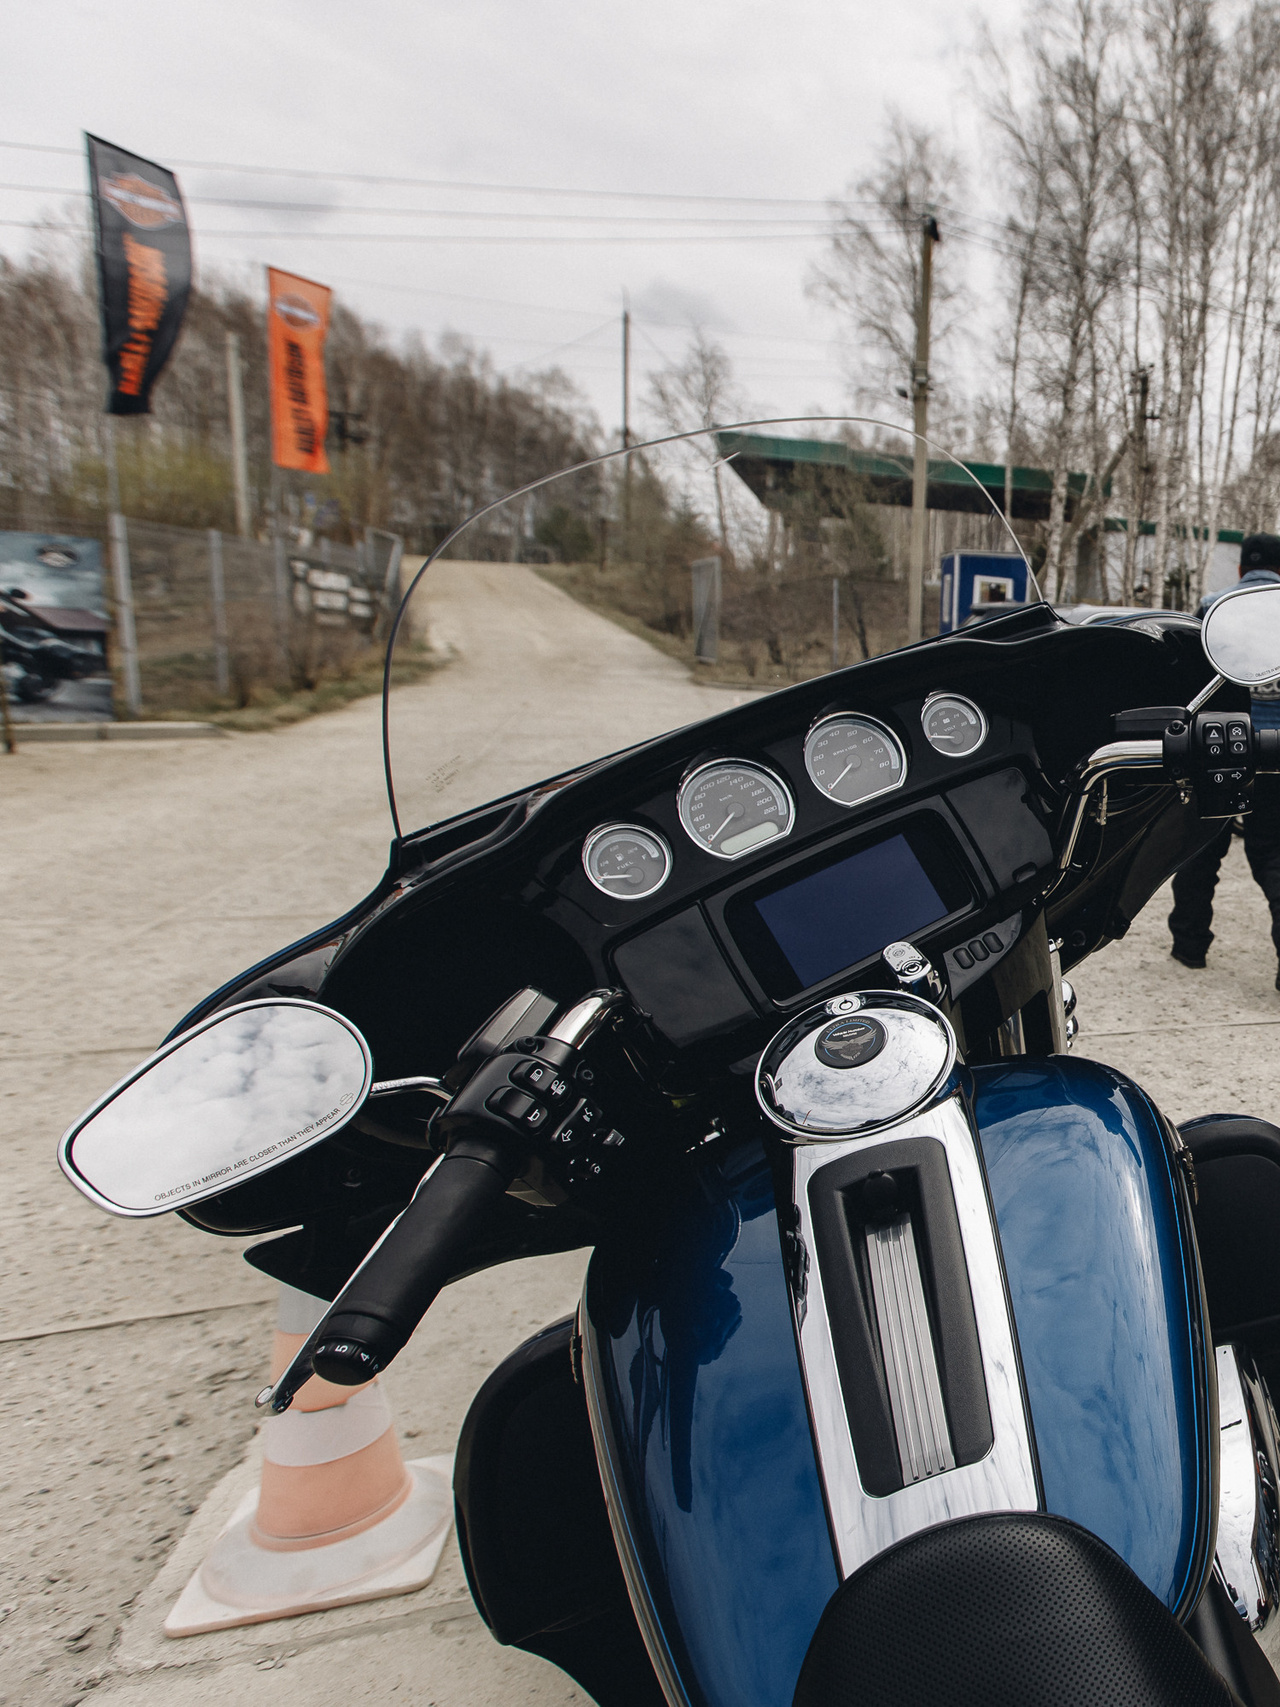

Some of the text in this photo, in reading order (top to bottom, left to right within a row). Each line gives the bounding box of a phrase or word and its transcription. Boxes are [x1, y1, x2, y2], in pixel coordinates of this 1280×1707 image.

[846, 730, 858, 738] 50
[817, 740, 828, 748] 30
[862, 736, 873, 744] 60
[813, 754, 824, 762] 20
[879, 760, 890, 768] 80
[817, 769, 825, 777] 10
[716, 775, 731, 784] 120
[729, 776, 744, 786] 140
[700, 782, 715, 792] 100
[740, 780, 755, 790] 160
[694, 792, 706, 801] 80
[752, 787, 766, 797] 180
[756, 796, 772, 806] 200
[691, 802, 703, 811] 60
[764, 805, 777, 815] 220
[693, 814, 705, 822] 40
[699, 823, 711, 833] 20
[617, 861, 634, 870] FUEL
[154, 1107, 341, 1201] OBJECTS IN MIRROR ARE CLOSER THAN THEY APPEAR
[334, 1345, 348, 1353] 5
[361, 1352, 370, 1361] 4
